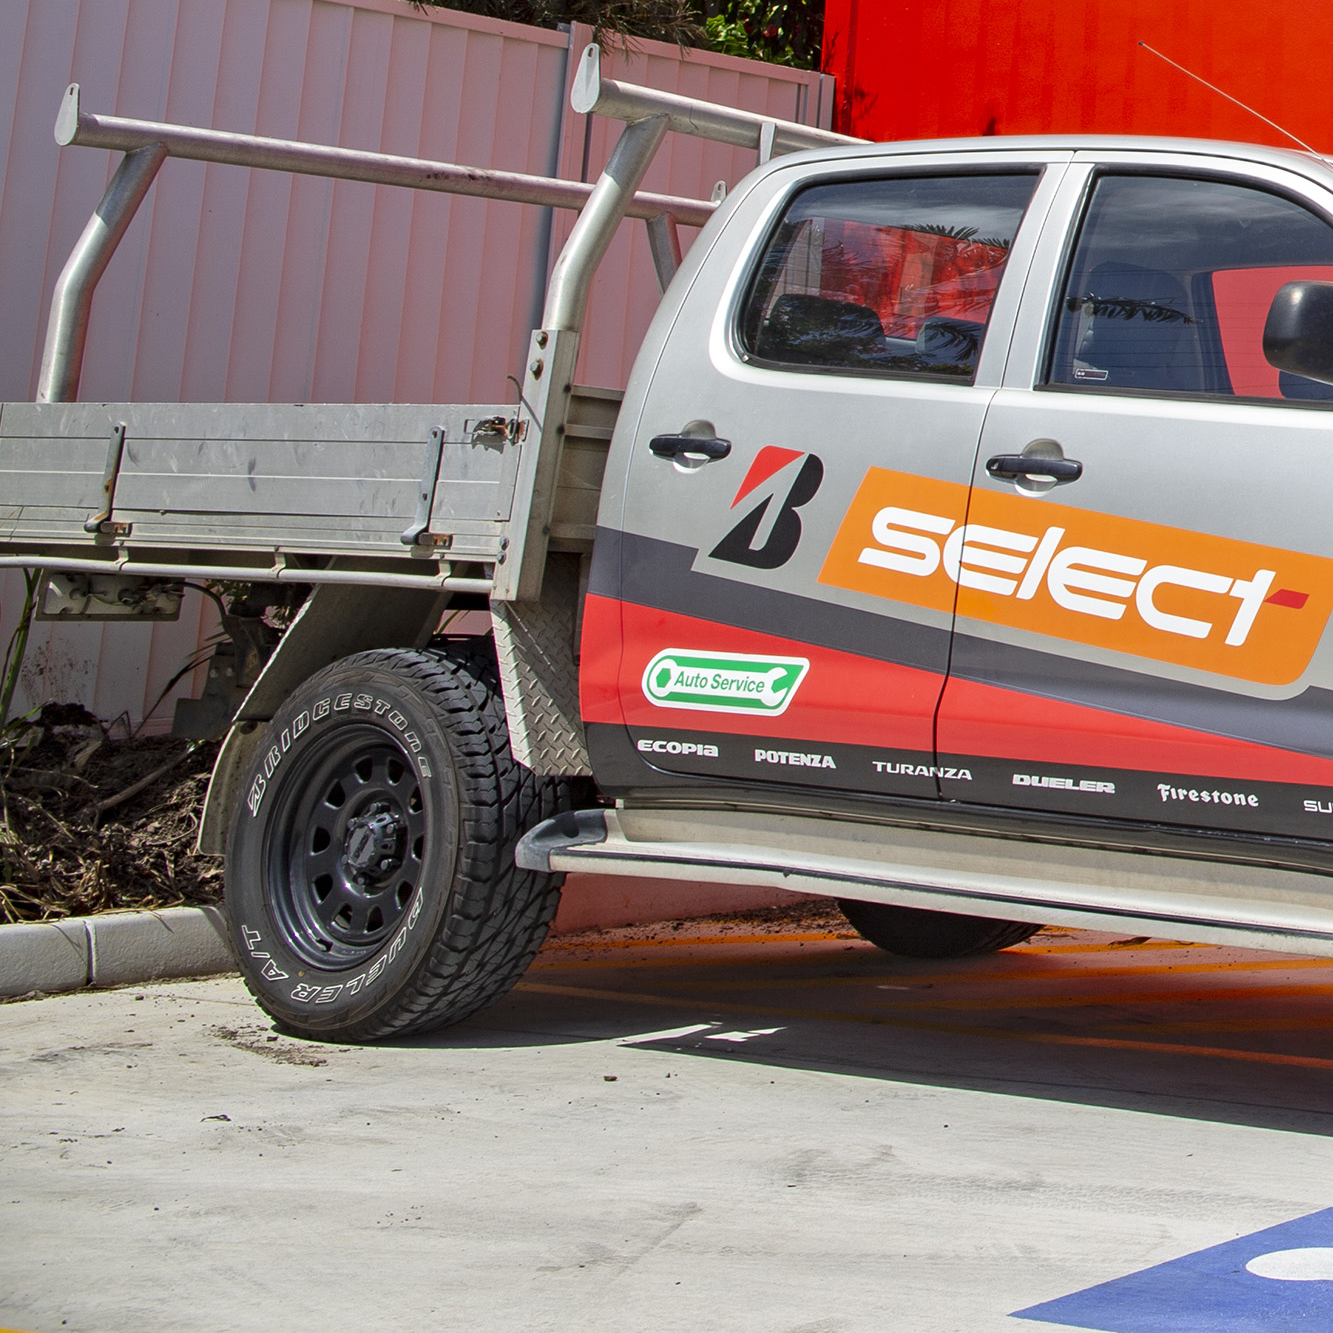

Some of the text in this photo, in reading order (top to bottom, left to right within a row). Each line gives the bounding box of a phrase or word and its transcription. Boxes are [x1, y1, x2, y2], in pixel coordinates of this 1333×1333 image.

[674, 670, 765, 693] Auto Service
[246, 692, 433, 818] BRIDGESTONE
[754, 748, 837, 770] POTENZA
[872, 761, 973, 781] TURANZA
[1012, 773, 1116, 794] DUELER
[1157, 782, 1260, 808] Firestone
[241, 886, 424, 1005] DUELER A/T
